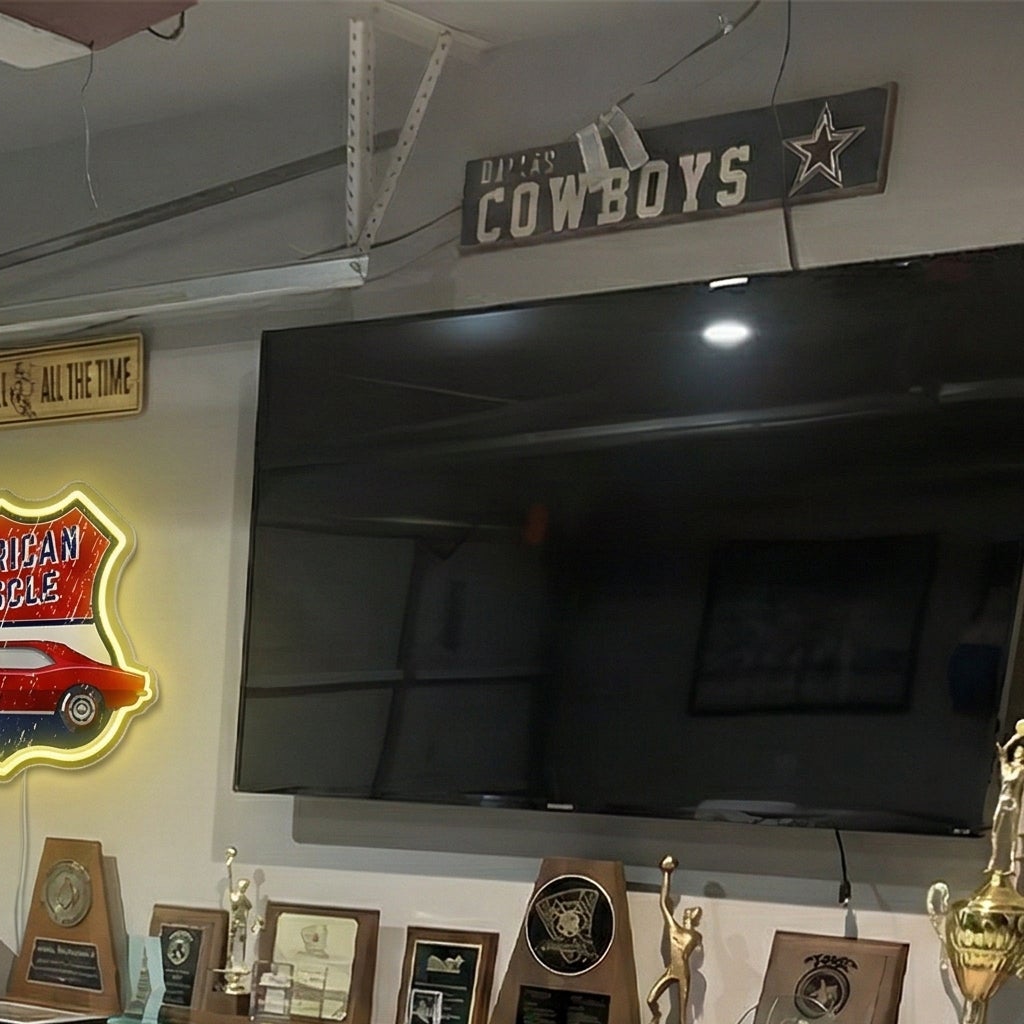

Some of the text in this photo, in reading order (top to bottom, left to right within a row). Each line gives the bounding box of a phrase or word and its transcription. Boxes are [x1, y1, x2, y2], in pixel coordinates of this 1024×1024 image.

[477, 145, 751, 243] COWBOYS
[40, 364, 65, 403] ALL
[67, 360, 93, 400] THE
[95, 356, 132, 397] TIME
